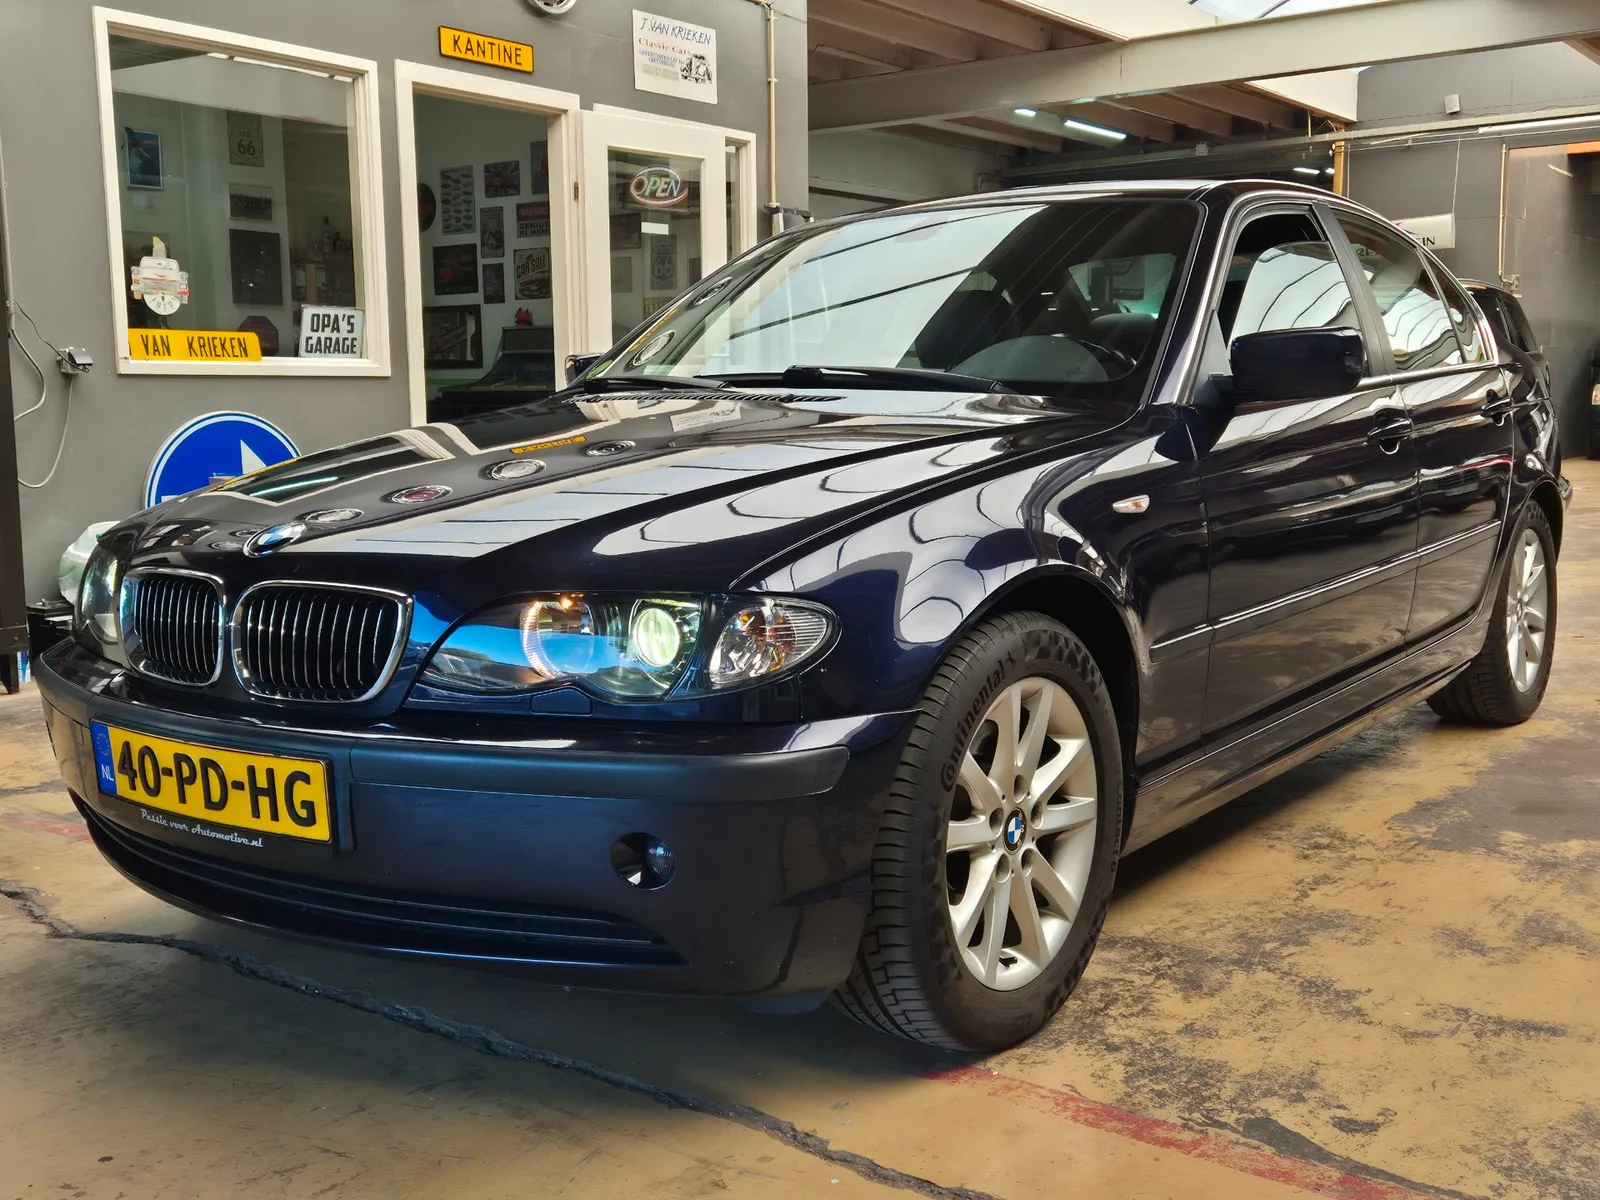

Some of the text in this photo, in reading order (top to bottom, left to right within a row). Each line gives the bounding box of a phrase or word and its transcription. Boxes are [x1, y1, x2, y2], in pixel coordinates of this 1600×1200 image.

[671, 26, 712, 45] KRIEKEN
[453, 34, 522, 66] KANTINE
[638, 37, 692, 56] Classic Cars
[237, 138, 256, 156] 66
[630, 175, 681, 198] OPEN
[516, 261, 530, 278] CAR
[310, 313, 355, 334] OPA'S
[140, 334, 249, 358] VAN KRIEKEN
[305, 337, 357, 355] GARAGE
[101, 763, 115, 782] NL
[117, 740, 317, 828] 40-PD-HG
[170, 820, 189, 832] voor
[191, 823, 263, 848] Automotive.nl
